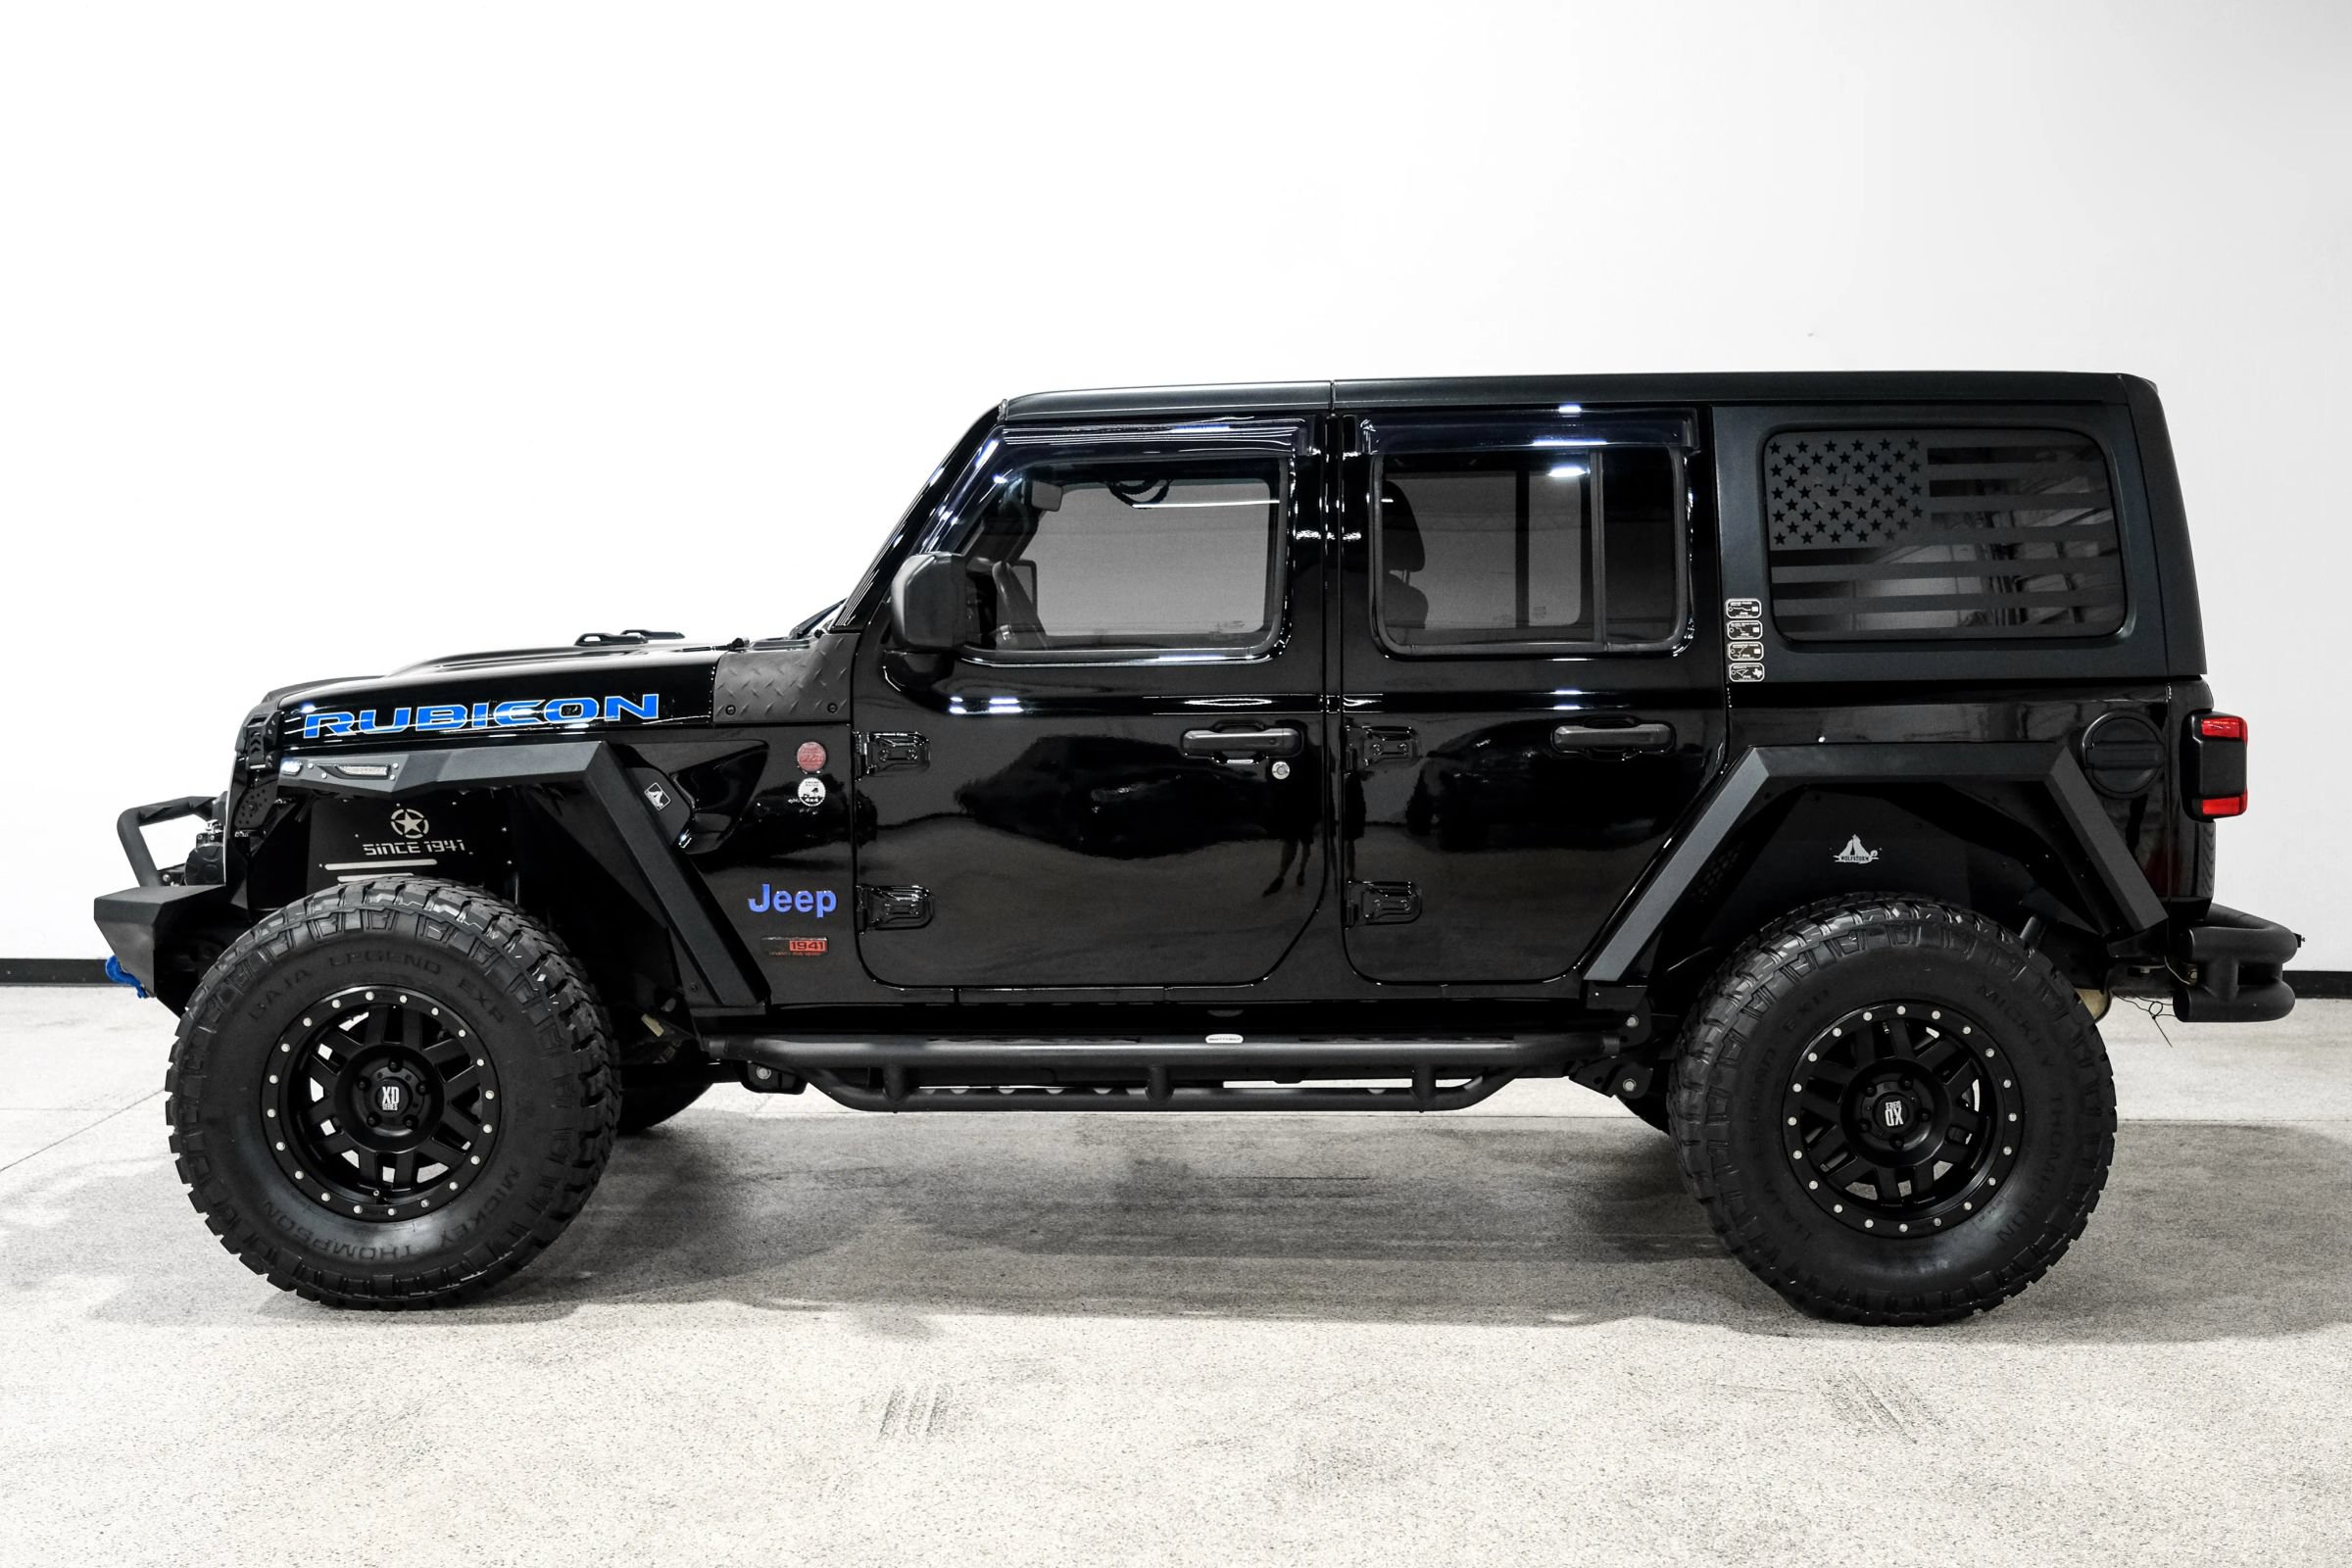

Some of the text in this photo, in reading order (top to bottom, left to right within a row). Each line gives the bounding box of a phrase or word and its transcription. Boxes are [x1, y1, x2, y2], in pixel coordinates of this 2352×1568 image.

[303, 693, 661, 739] RUBICON
[363, 839, 466, 856] SINCE 1941
[747, 883, 838, 918] Jeep
[790, 941, 825, 952] 1941
[382, 1086, 400, 1104] XD
[1885, 1107, 1904, 1126] XD
[260, 1200, 420, 1261] THOMPSON
